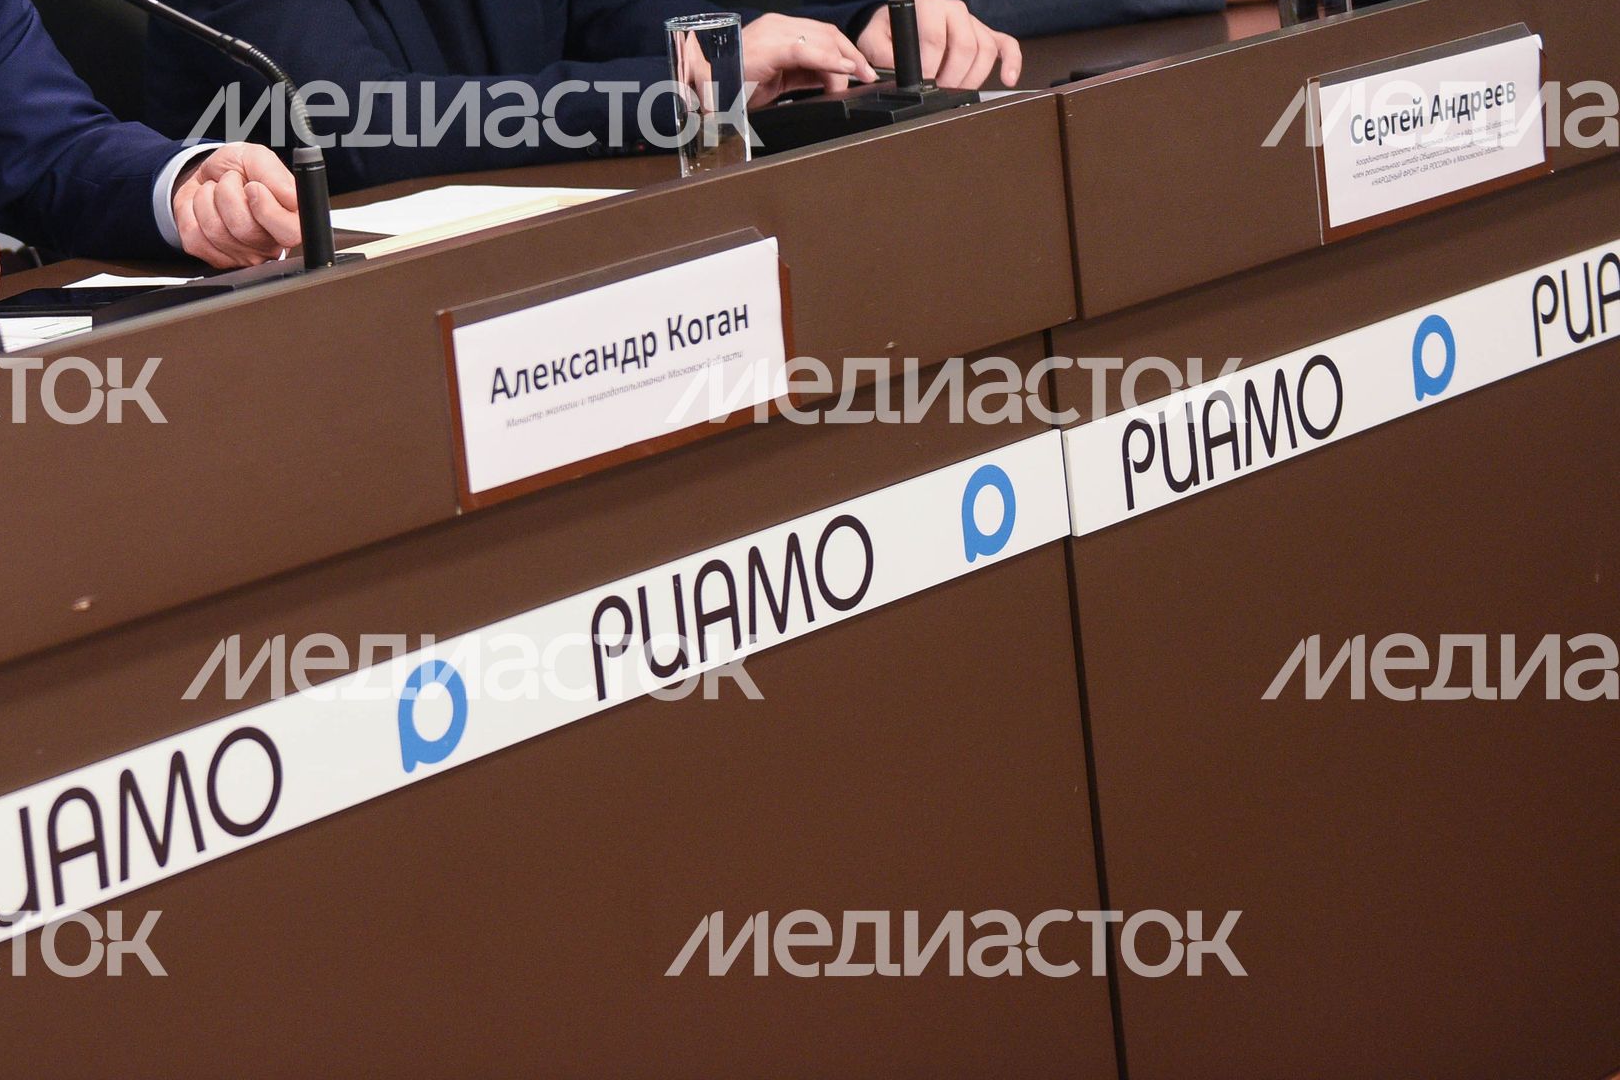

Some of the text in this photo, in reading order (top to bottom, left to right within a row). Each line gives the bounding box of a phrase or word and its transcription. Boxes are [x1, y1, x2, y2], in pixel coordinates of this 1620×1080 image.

[1350, 96, 1424, 147] Сергей
[1429, 81, 1517, 125] Андреев
[490, 304, 750, 404] Александр Коган
[1121, 354, 1344, 511] РИАМО
[590, 514, 874, 701] РИАМО
